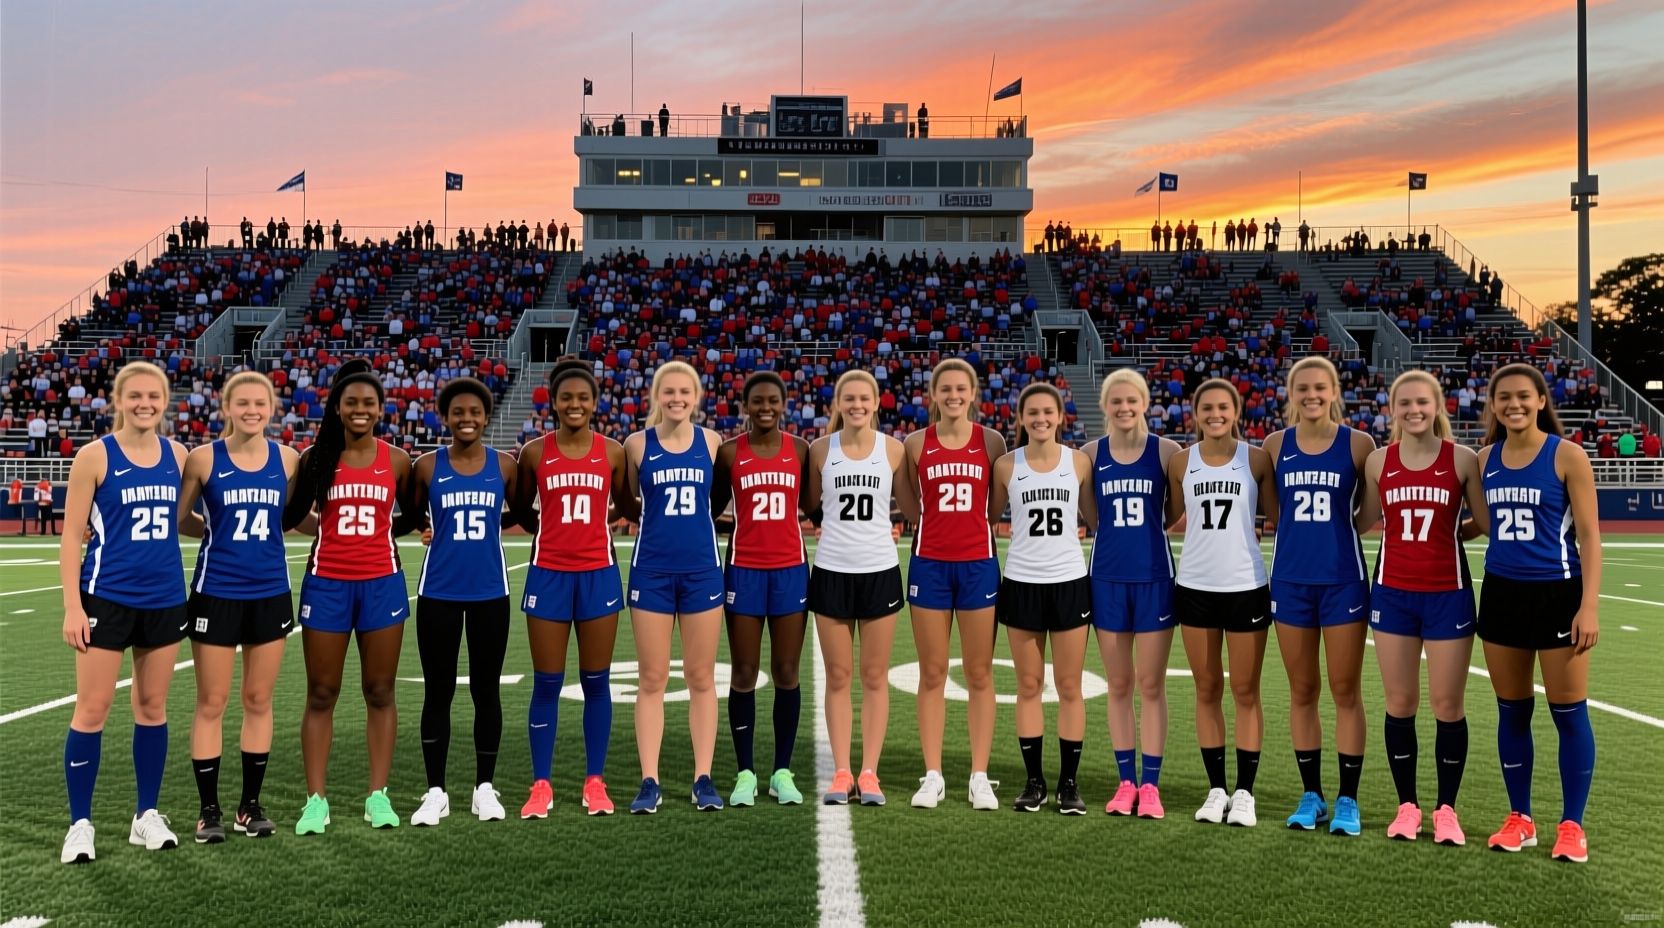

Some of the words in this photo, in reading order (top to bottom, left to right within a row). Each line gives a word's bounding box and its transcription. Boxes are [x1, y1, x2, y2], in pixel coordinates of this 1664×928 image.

[561, 494, 591, 524] 14
[664, 486, 697, 516] 29
[752, 492, 786, 521] 20
[839, 493, 874, 521] 20
[938, 483, 972, 512] 29
[1112, 497, 1144, 527] 19
[131, 506, 170, 541] 25
[337, 505, 376, 536] 25
[453, 510, 486, 541] 15
[1028, 507, 1063, 537] 26
[1200, 499, 1233, 530] 17
[1400, 508, 1434, 542] 17
[1496, 508, 1535, 541] 25
